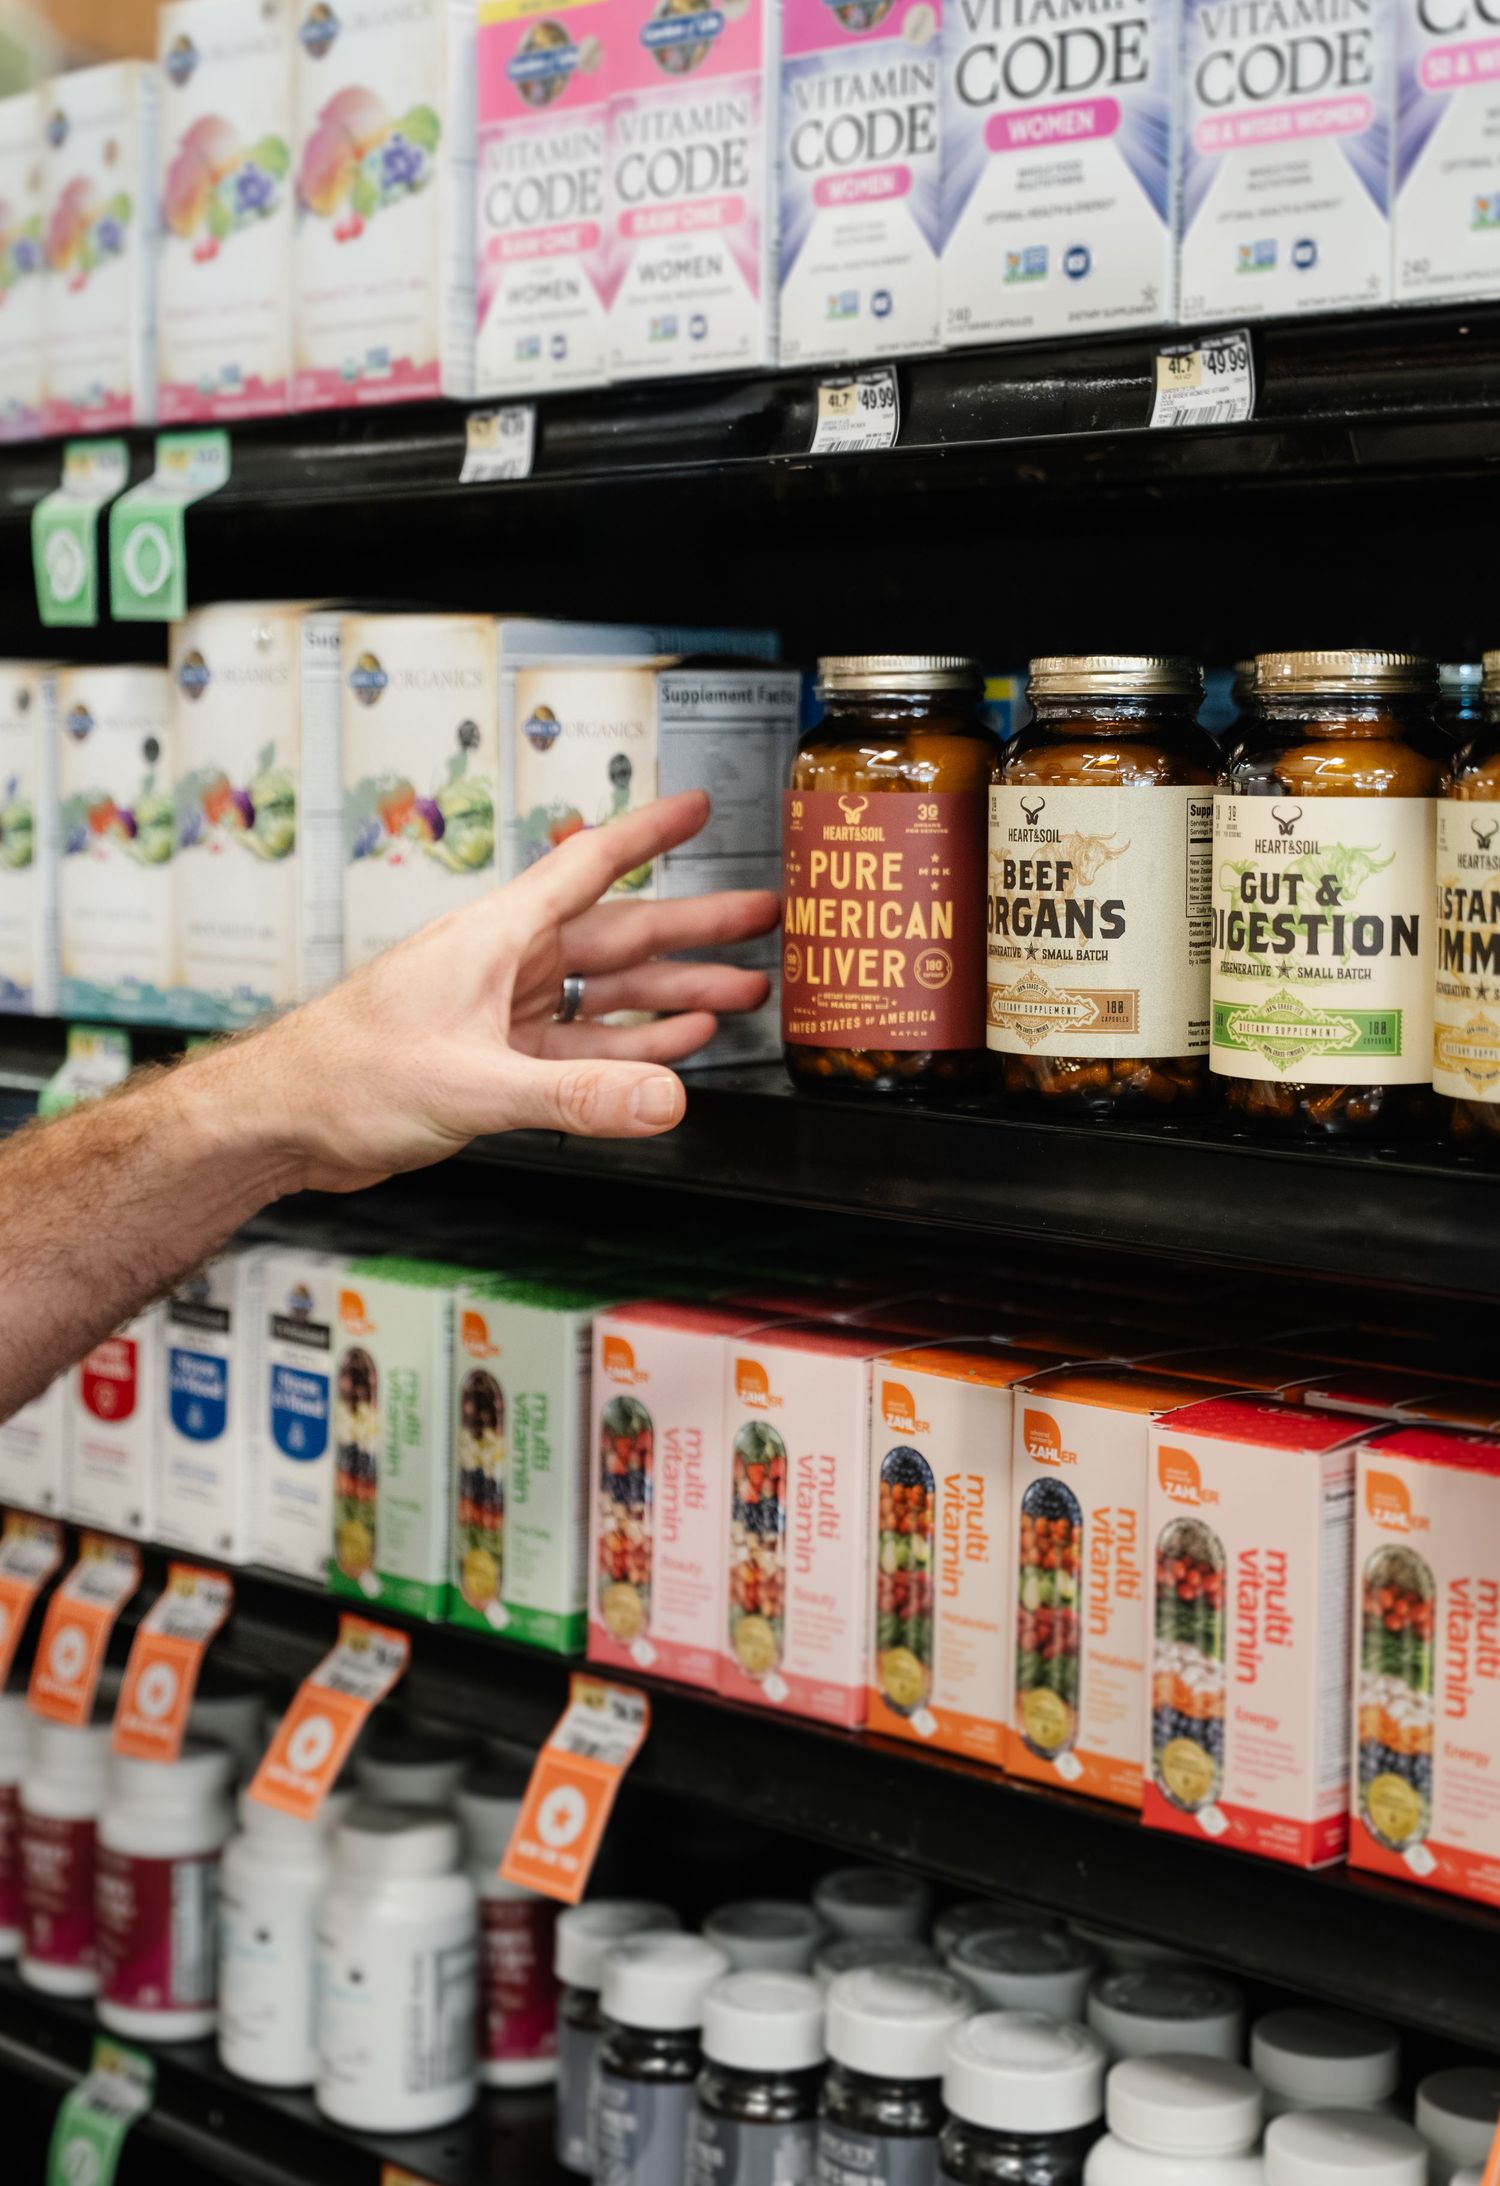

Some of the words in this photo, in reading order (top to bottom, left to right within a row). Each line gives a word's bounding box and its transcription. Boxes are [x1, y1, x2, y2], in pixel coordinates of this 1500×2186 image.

[955, 18, 1148, 107] CODE
[1195, 27, 1372, 108] CODE
[794, 60, 936, 111] VITAMIN
[619, 98, 748, 145] VITAMIN
[790, 101, 937, 172] CODE
[1006, 107, 1094, 143] WOMEN
[615, 137, 748, 203] CODE
[829, 174, 895, 199] WOMEN
[485, 165, 603, 227] CODE
[637, 254, 723, 283] WOMEN
[506, 278, 580, 305] WOMEN
[662, 686, 753, 707] Supplement
[757, 685, 796, 704] Facts
[1008, 828, 1062, 843] HEART&SOIL
[1255, 839, 1322, 855] HEART&SOIL
[810, 850, 903, 891] PURE
[1003, 859, 1074, 892] BEEF
[1240, 871, 1304, 905] GUT
[1315, 874, 1343, 906] &
[785, 897, 953, 940] AMERICAN
[1211, 907, 1420, 957] DIGESTION
[806, 946, 906, 988] LIVER
[1042, 948, 1073, 960] SMALL
[1076, 949, 1109, 961] BATCH
[1297, 967, 1333, 979] SMALL
[1337, 968, 1371, 980] BATCH
[819, 1016, 861, 1033] STATES
[879, 1010, 936, 1026] AMERICA
[1025, 1004, 1077, 1016] SUPPLEMENT
[1239, 1023, 1270, 1034] DIETARY
[1275, 1025, 1337, 1038] SUPPLEMENT
[886, 1413, 930, 1434] ZAHLER
[684, 1428, 707, 1511] multi
[1029, 1443, 1078, 1466] ZAHLER
[661, 1427, 682, 1543] vitamin
[818, 1455, 841, 1541] multi
[1164, 1481, 1220, 1505] ZAHLER
[795, 1454, 816, 1574] vitamin
[942, 1473, 965, 1597] vitamin
[965, 1474, 991, 1563] multi
[1088, 1506, 1115, 1636] vitamin
[1114, 1507, 1142, 1601] multi
[1235, 1548, 1264, 1685] vitamin
[1264, 1549, 1294, 1649] multi
[1444, 1577, 1473, 1719] vitamin
[1234, 1705, 1280, 1732] Energy
[1443, 1741, 1490, 1768] Energy
